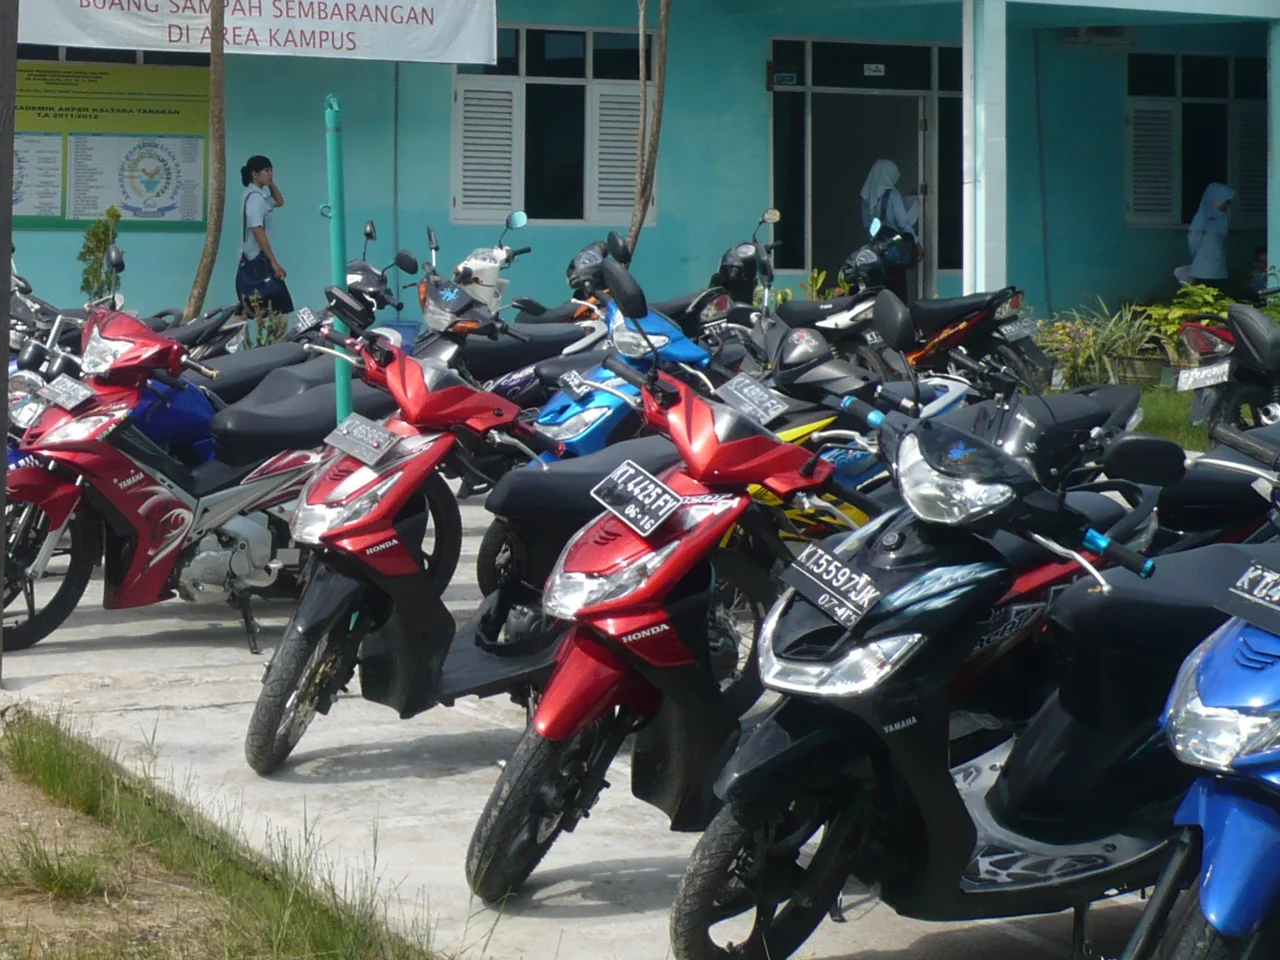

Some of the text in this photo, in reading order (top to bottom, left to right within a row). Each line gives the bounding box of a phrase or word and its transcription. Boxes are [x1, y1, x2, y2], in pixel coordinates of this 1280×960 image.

[272, 0, 435, 25] SEMBARANGAN
[168, 24, 190, 44] DI
[269, 28, 357, 51] KAMPUS
[119, 472, 145, 489] YAMAHA
[610, 464, 635, 484] KT
[627, 475, 662, 506] 4425
[651, 495, 678, 516] FY
[365, 539, 399, 555] HONDA
[813, 557, 859, 591] 5597
[622, 623, 670, 643] HONDA
[883, 716, 918, 734] YAMAHA
